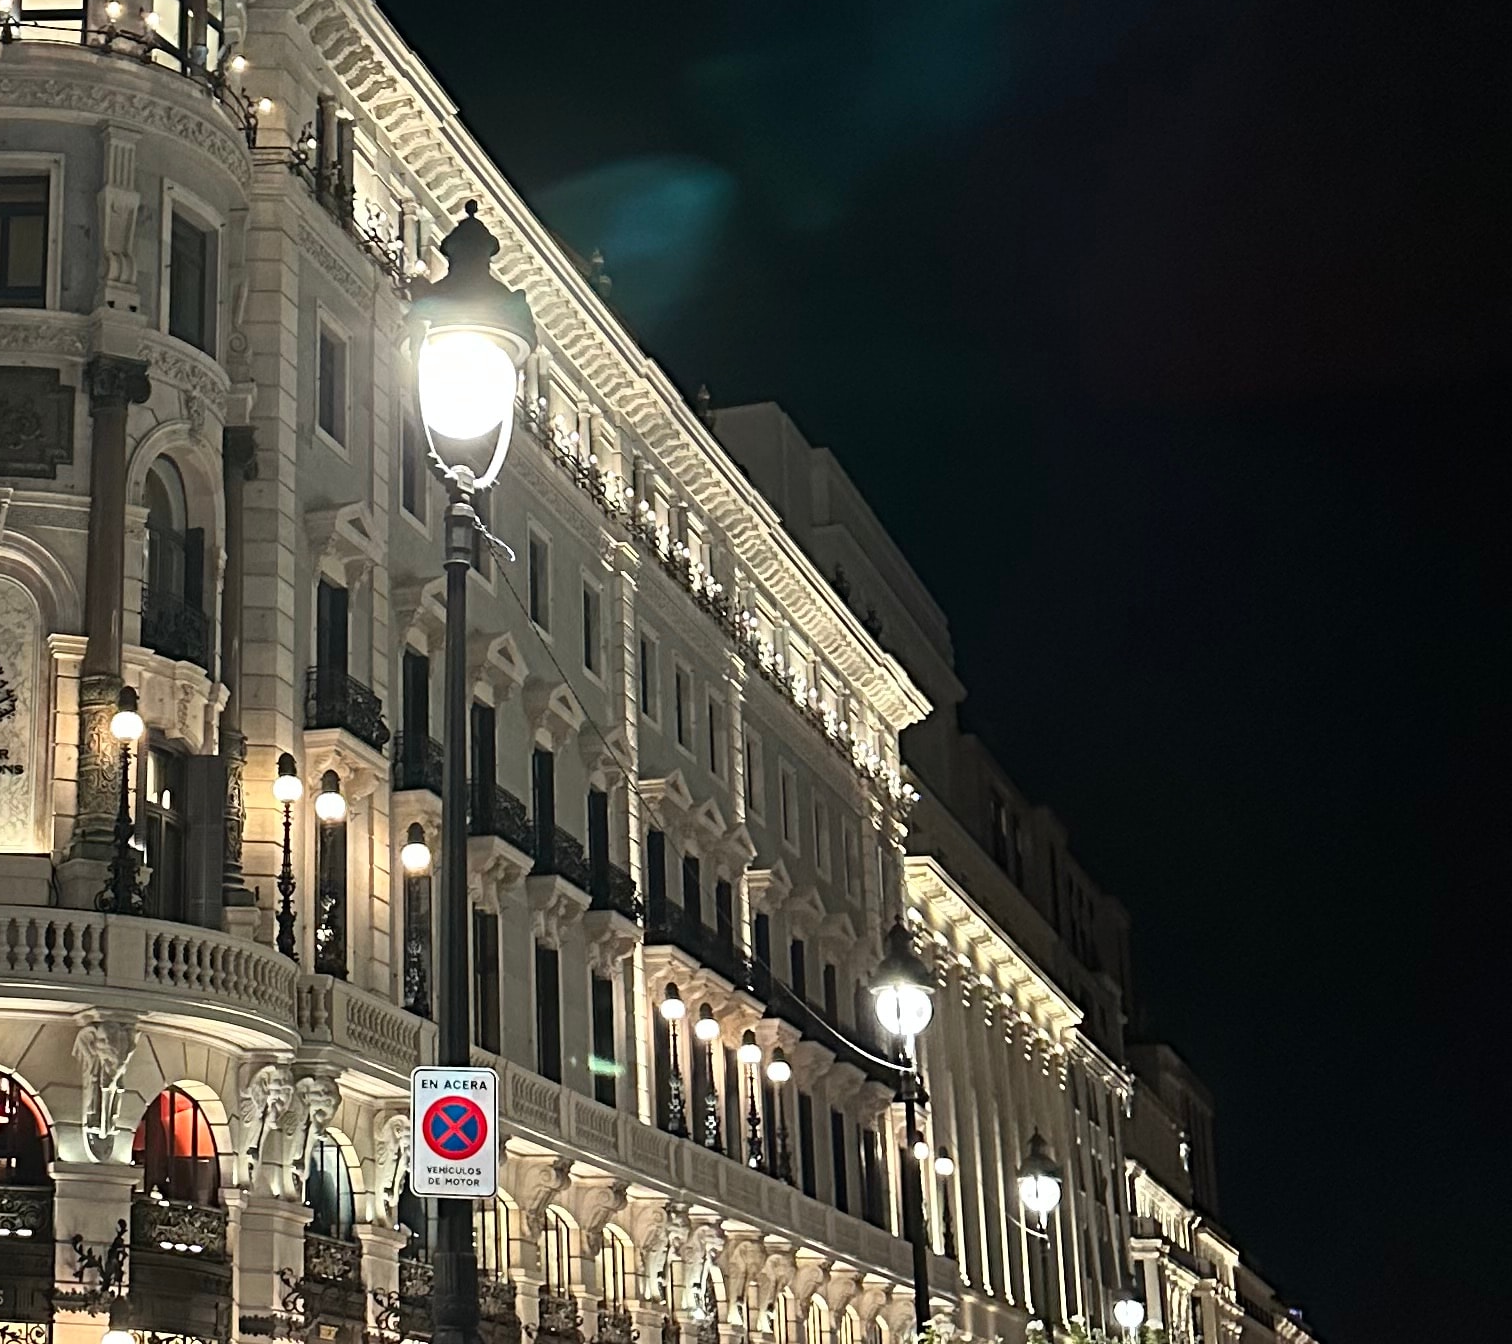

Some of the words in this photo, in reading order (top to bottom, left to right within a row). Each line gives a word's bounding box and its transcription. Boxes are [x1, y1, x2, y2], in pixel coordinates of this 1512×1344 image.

[421, 1079, 438, 1089] EN
[444, 1079, 488, 1090] ACERA
[427, 1165, 482, 1175] VEHÍCULOS
[428, 1177, 440, 1186] DE
[445, 1177, 480, 1186] MOTOR
